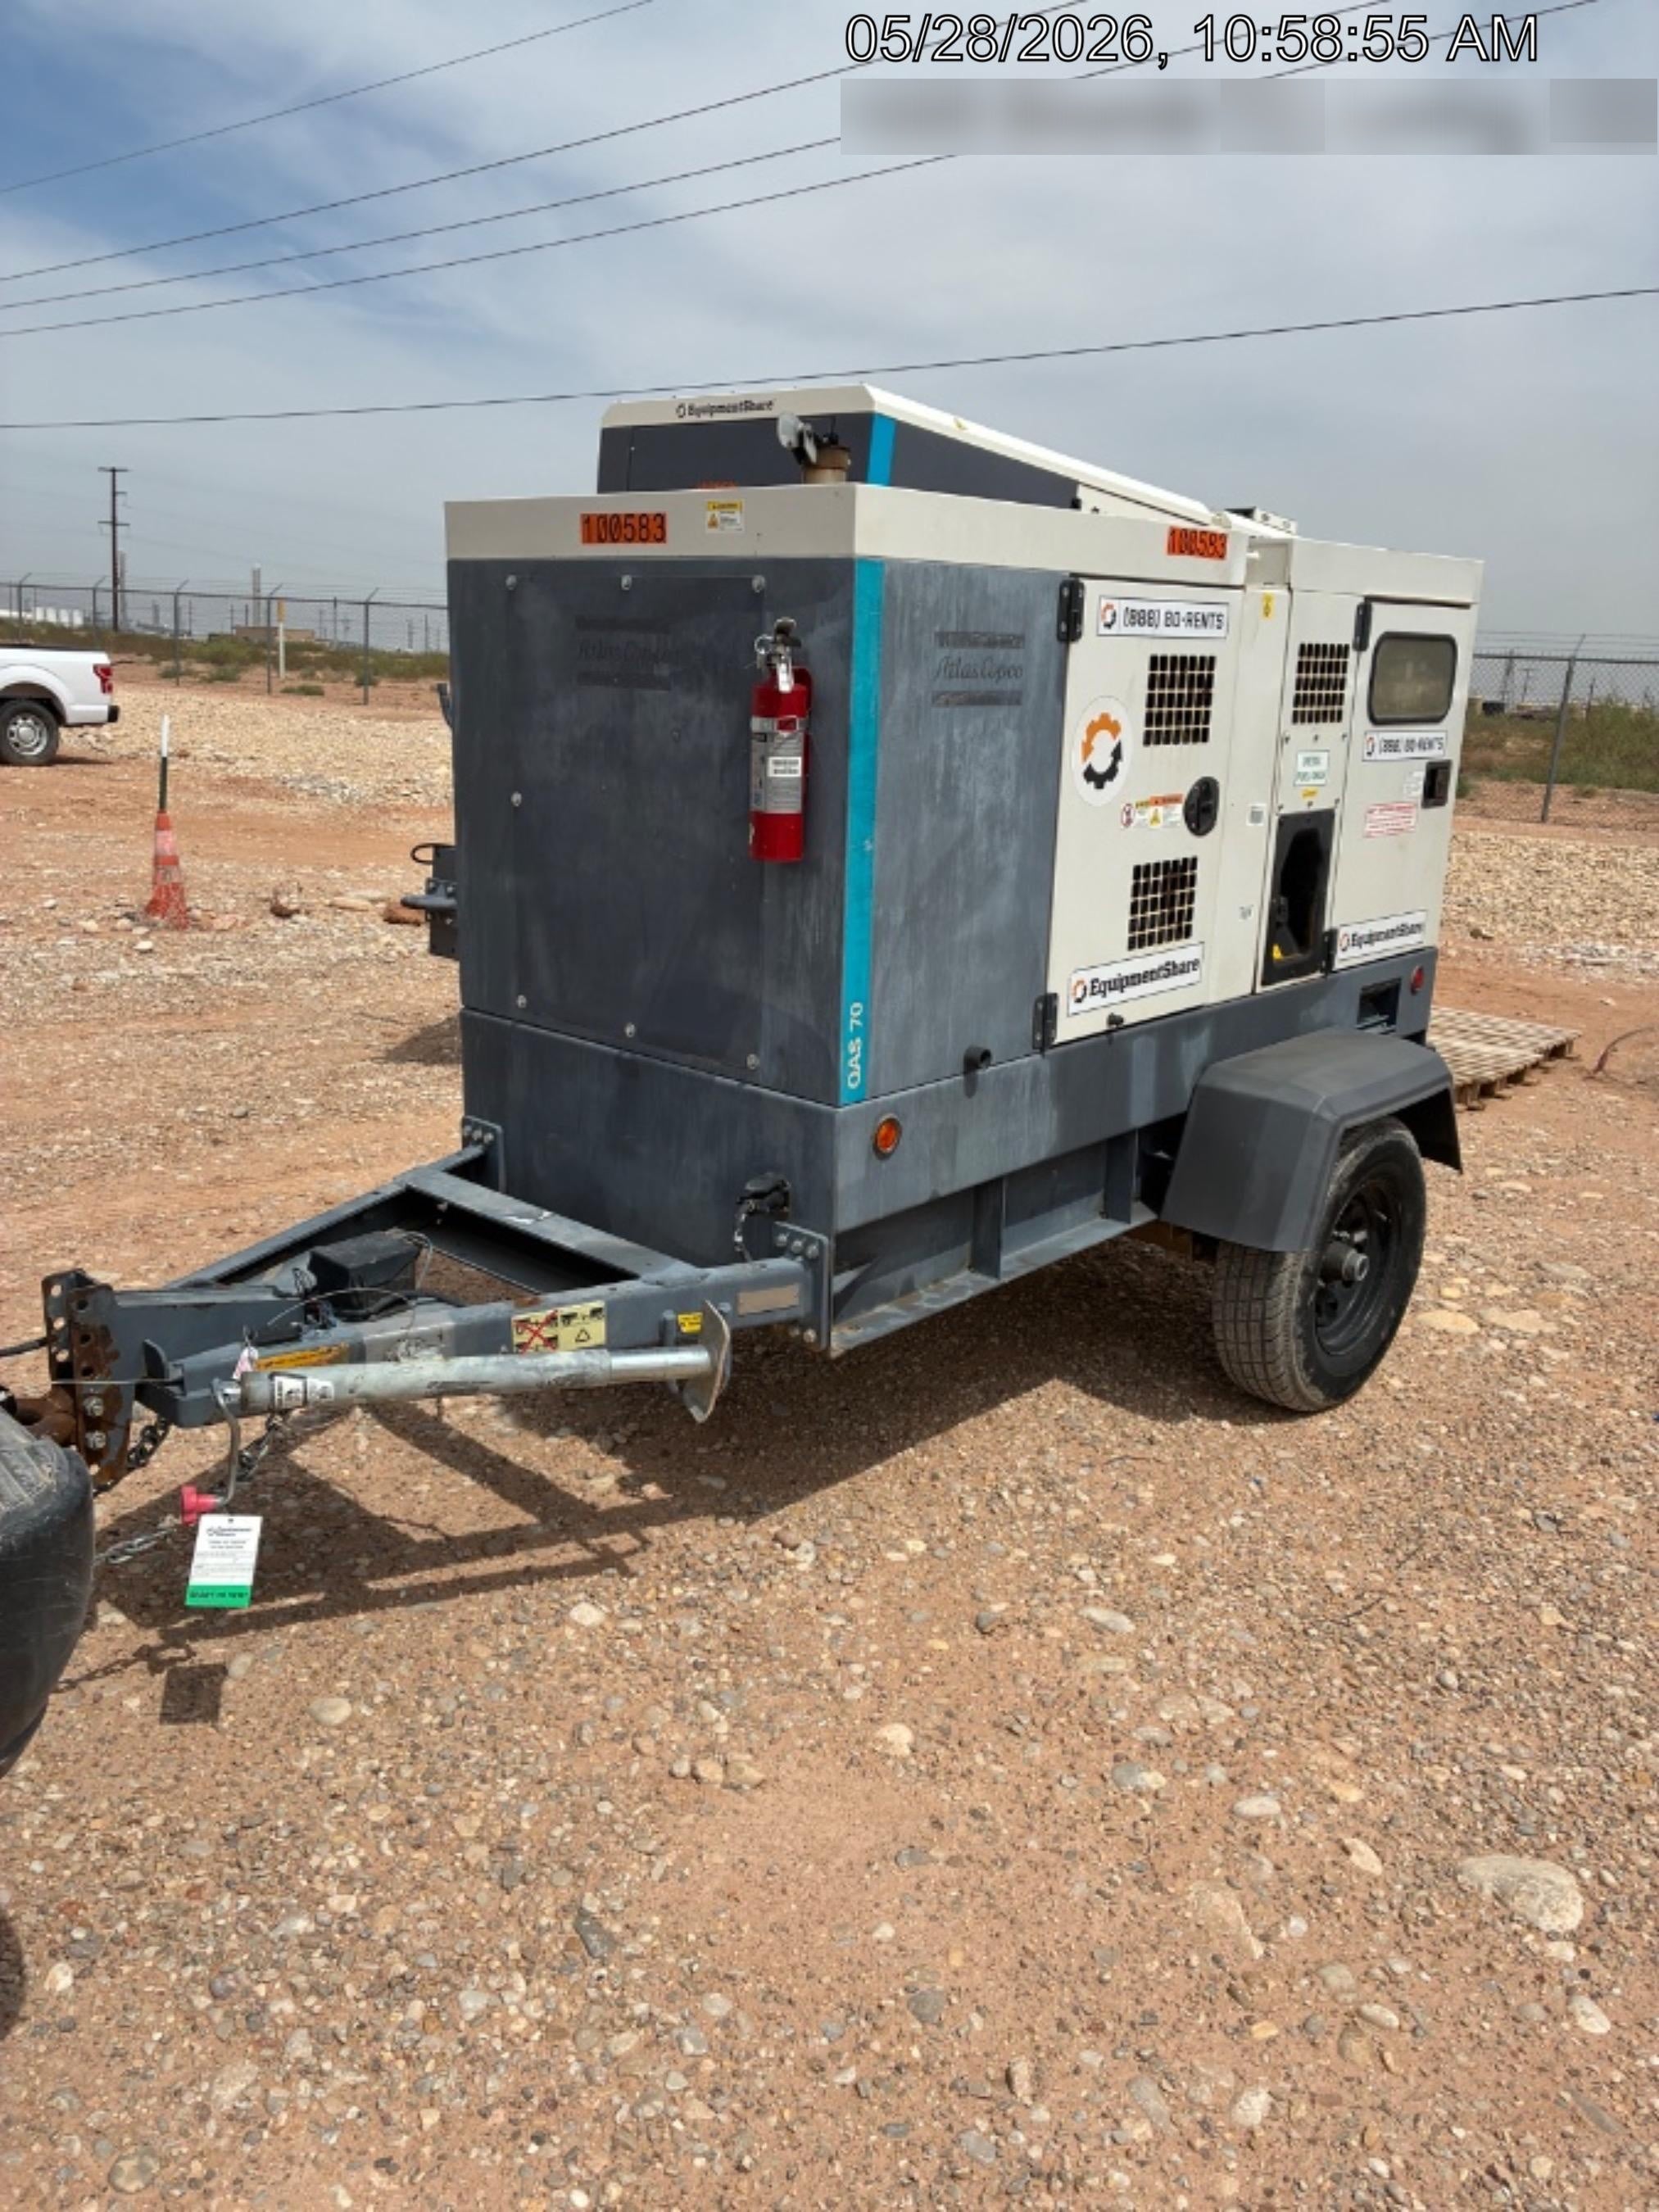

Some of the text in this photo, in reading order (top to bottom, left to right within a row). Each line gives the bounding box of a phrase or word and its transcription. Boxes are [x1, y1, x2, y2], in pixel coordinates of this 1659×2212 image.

[582, 514, 667, 543] 100583
[1351, 922, 1423, 949] EquipmentShare
[1090, 958, 1200, 997] EquipmentShare
[850, 1001, 863, 1033] 70
